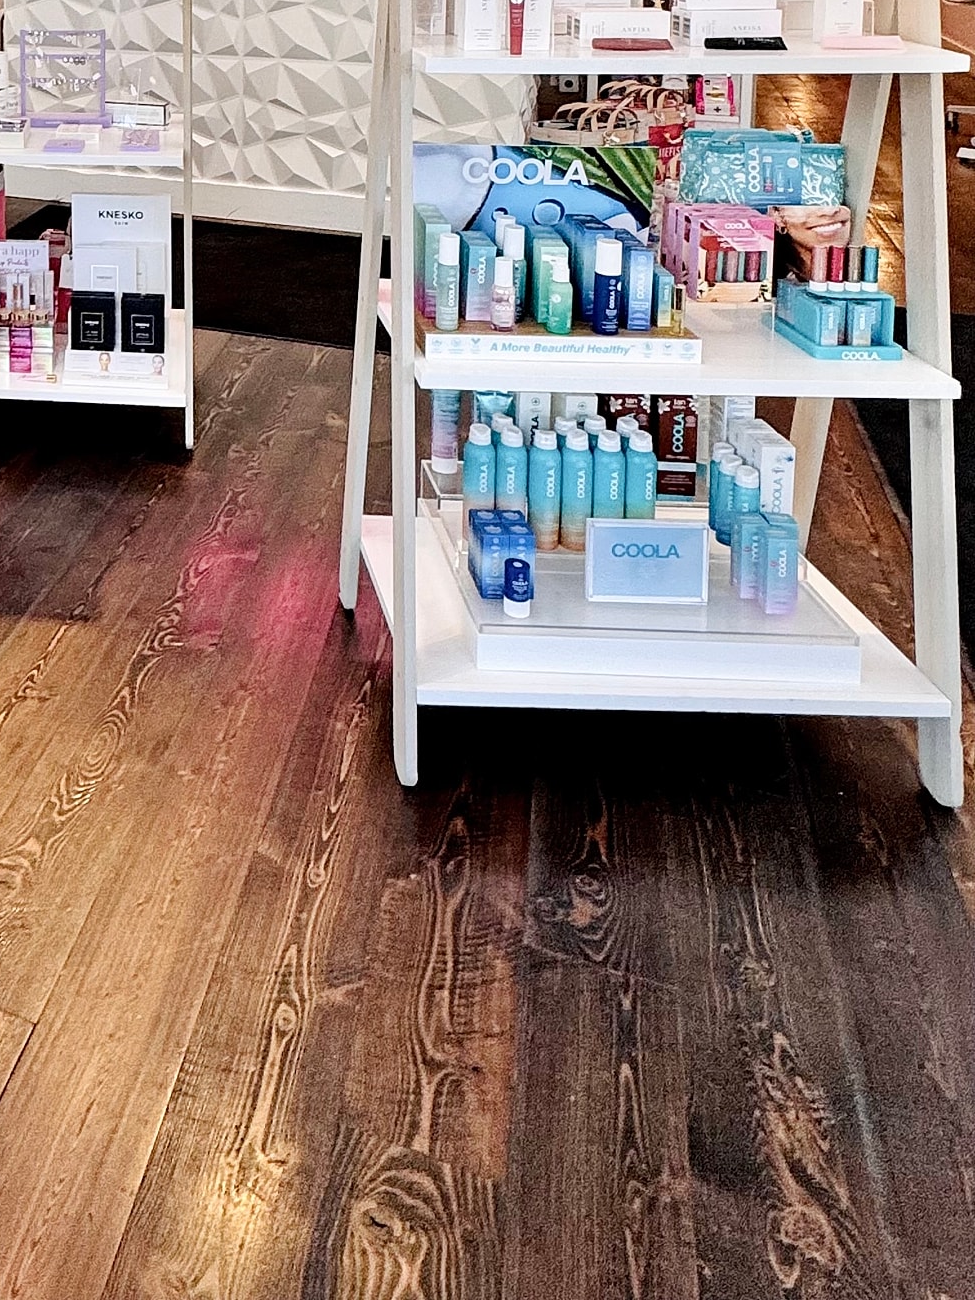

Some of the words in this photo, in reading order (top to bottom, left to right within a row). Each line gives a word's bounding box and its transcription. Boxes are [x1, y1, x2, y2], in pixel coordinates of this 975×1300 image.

[462, 157, 589, 186] COOLA
[748, 145, 760, 193] COOLA
[98, 210, 144, 220] KNESKO
[11, 245, 39, 257] happ
[478, 255, 487, 284] COOLA
[489, 341, 499, 352] A
[500, 342, 530, 352] More
[533, 343, 585, 354] Beautiful
[587, 345, 631, 357] Healthy
[841, 351, 881, 360] COOLA
[672, 413, 684, 452] COOLA
[480, 464, 488, 493] COOLA
[506, 466, 515, 495] COOLA
[546, 468, 555, 498] COOLA
[577, 470, 585, 499] COOLA
[610, 471, 618, 500] COOLA
[645, 471, 654, 500] COOLA
[611, 543, 680, 558] COOLA
[778, 550, 787, 578] COOLA
